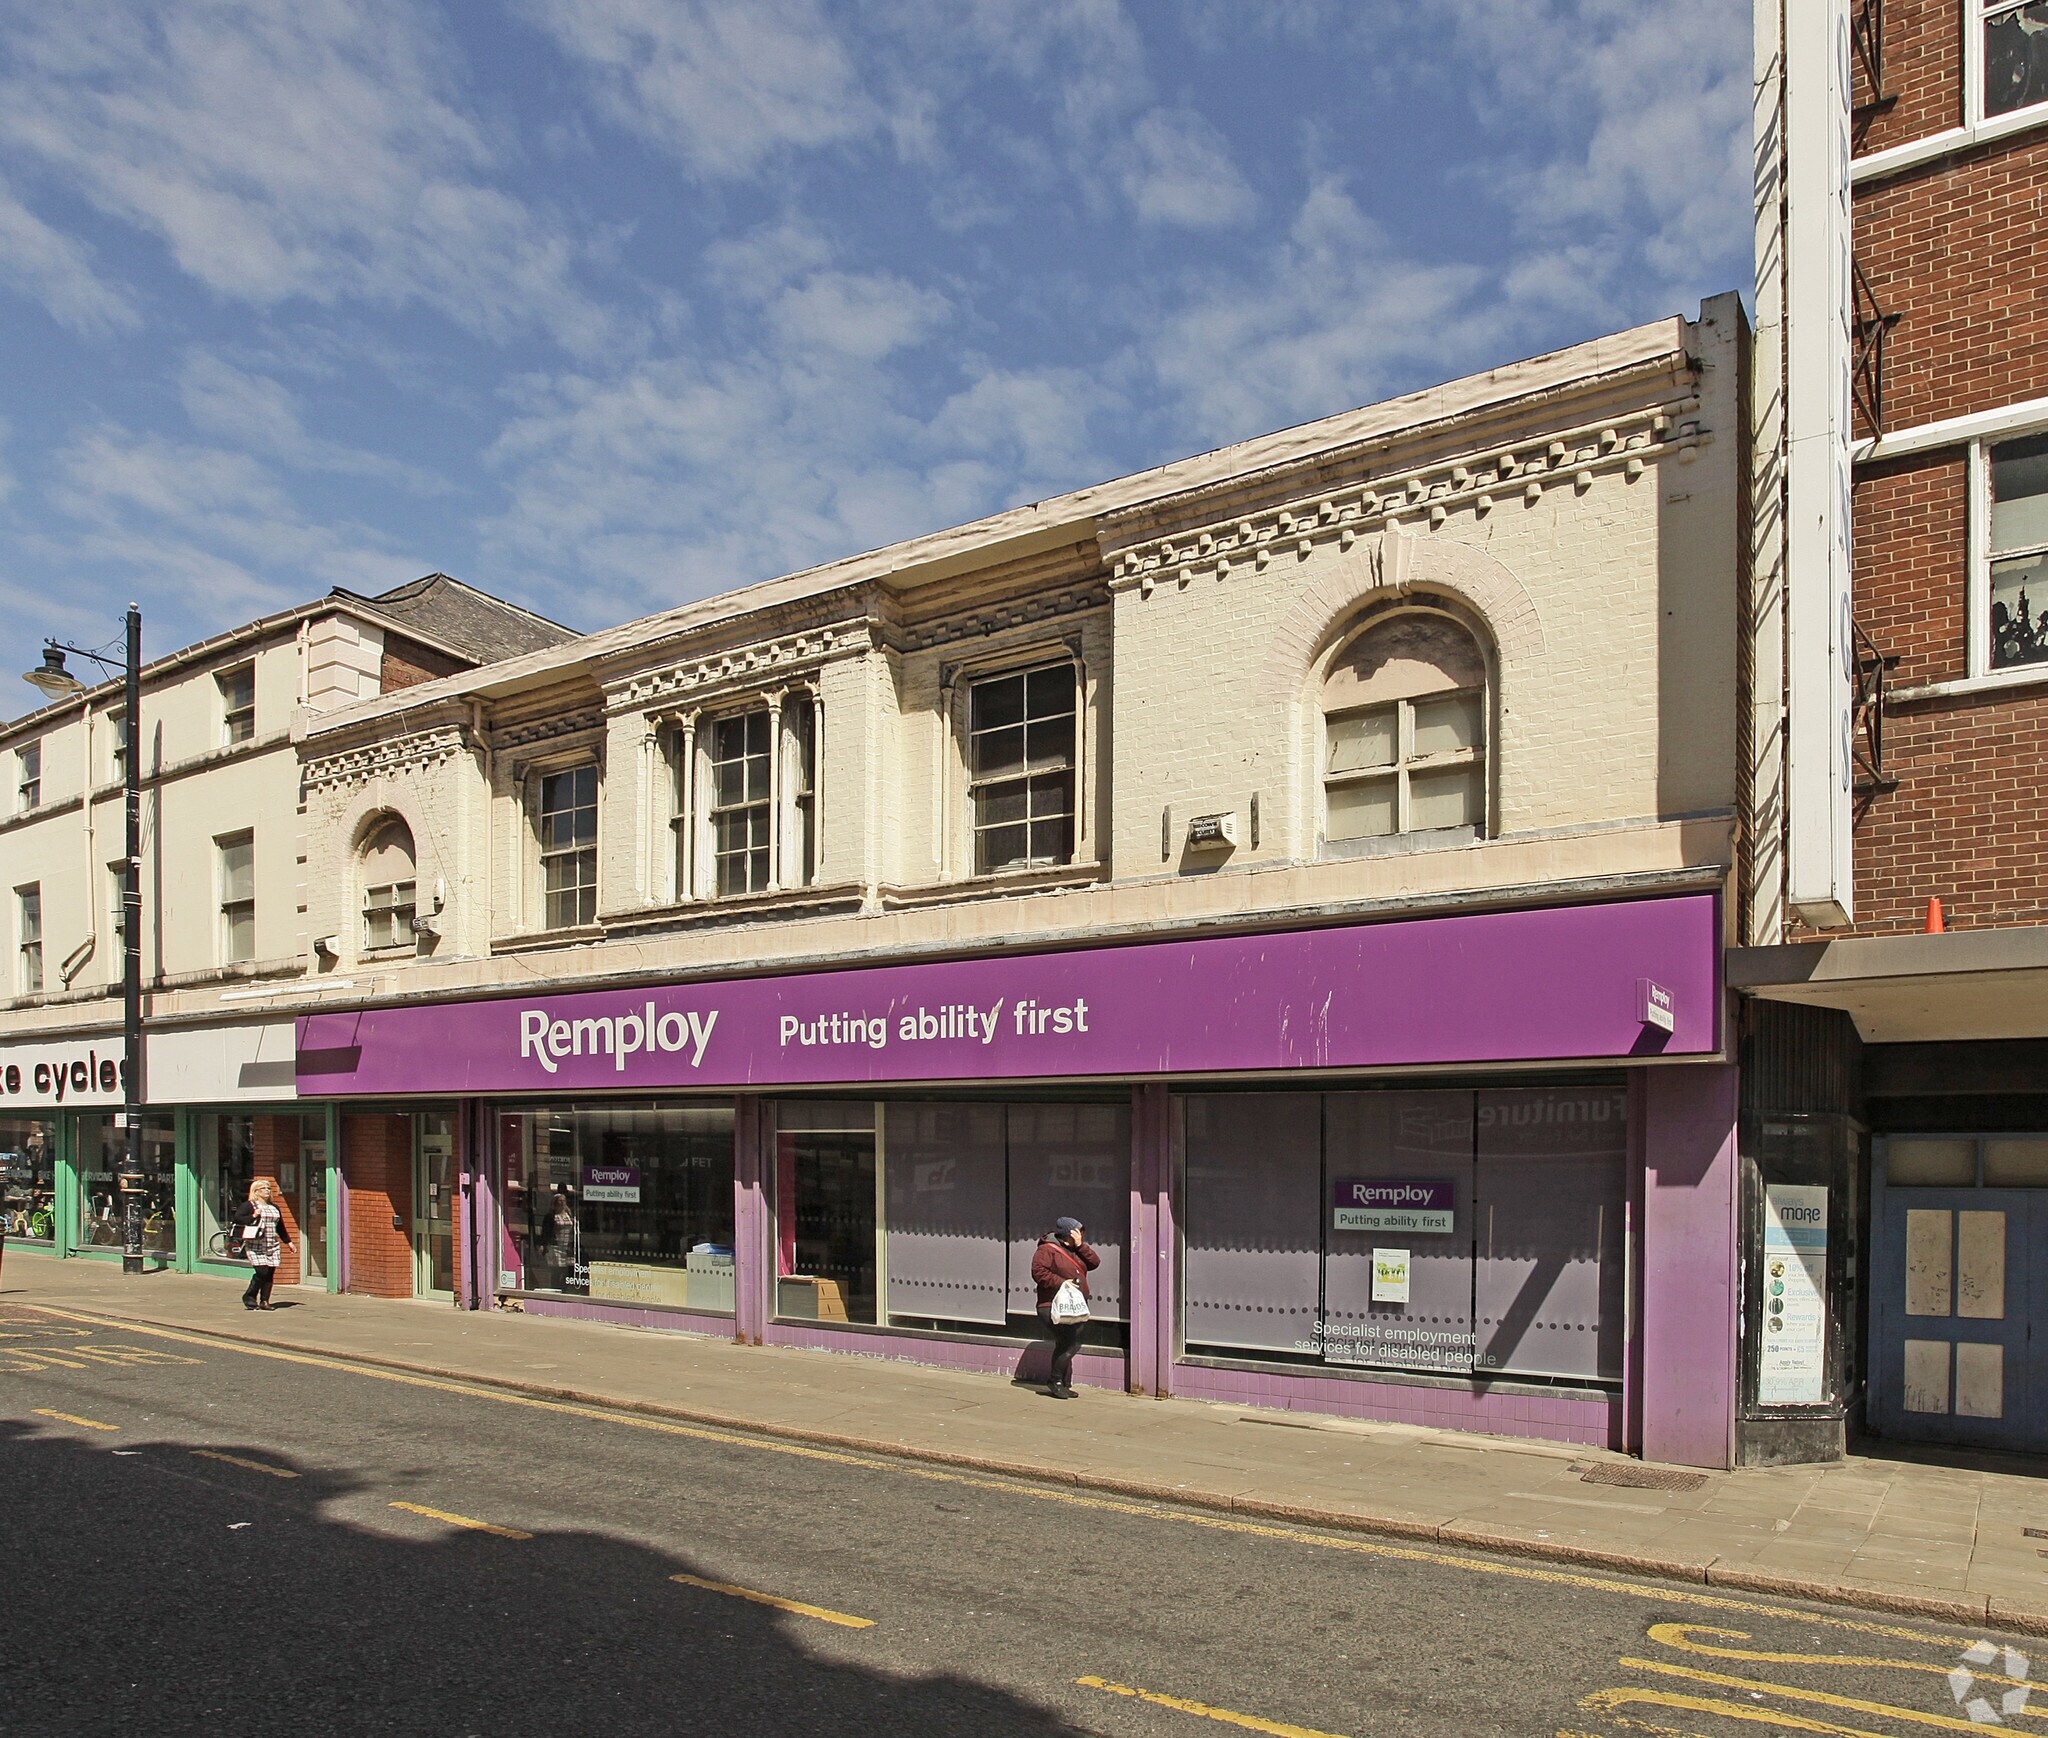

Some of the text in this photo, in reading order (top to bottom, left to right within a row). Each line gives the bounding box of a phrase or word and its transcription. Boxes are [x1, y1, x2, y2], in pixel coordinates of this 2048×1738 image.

[1651, 984, 1670, 1009] Remploy
[779, 998, 1089, 1049] Putting ability first
[520, 1001, 719, 1074] Remploy
[0, 1064, 22, 1095] e
[157, 1173, 175, 1184] PART
[591, 1168, 631, 1183] Remploy
[585, 1189, 637, 1199] Putting ability first
[1352, 1184, 1434, 1206] Remploy
[1340, 1213, 1447, 1228] Putting ability first
[1786, 1312, 1816, 1321] Rewards
[1313, 1320, 1476, 1346] Specialist employment
[1294, 1339, 1496, 1368] services for disabled people
[1767, 1344, 1779, 1353] 250
